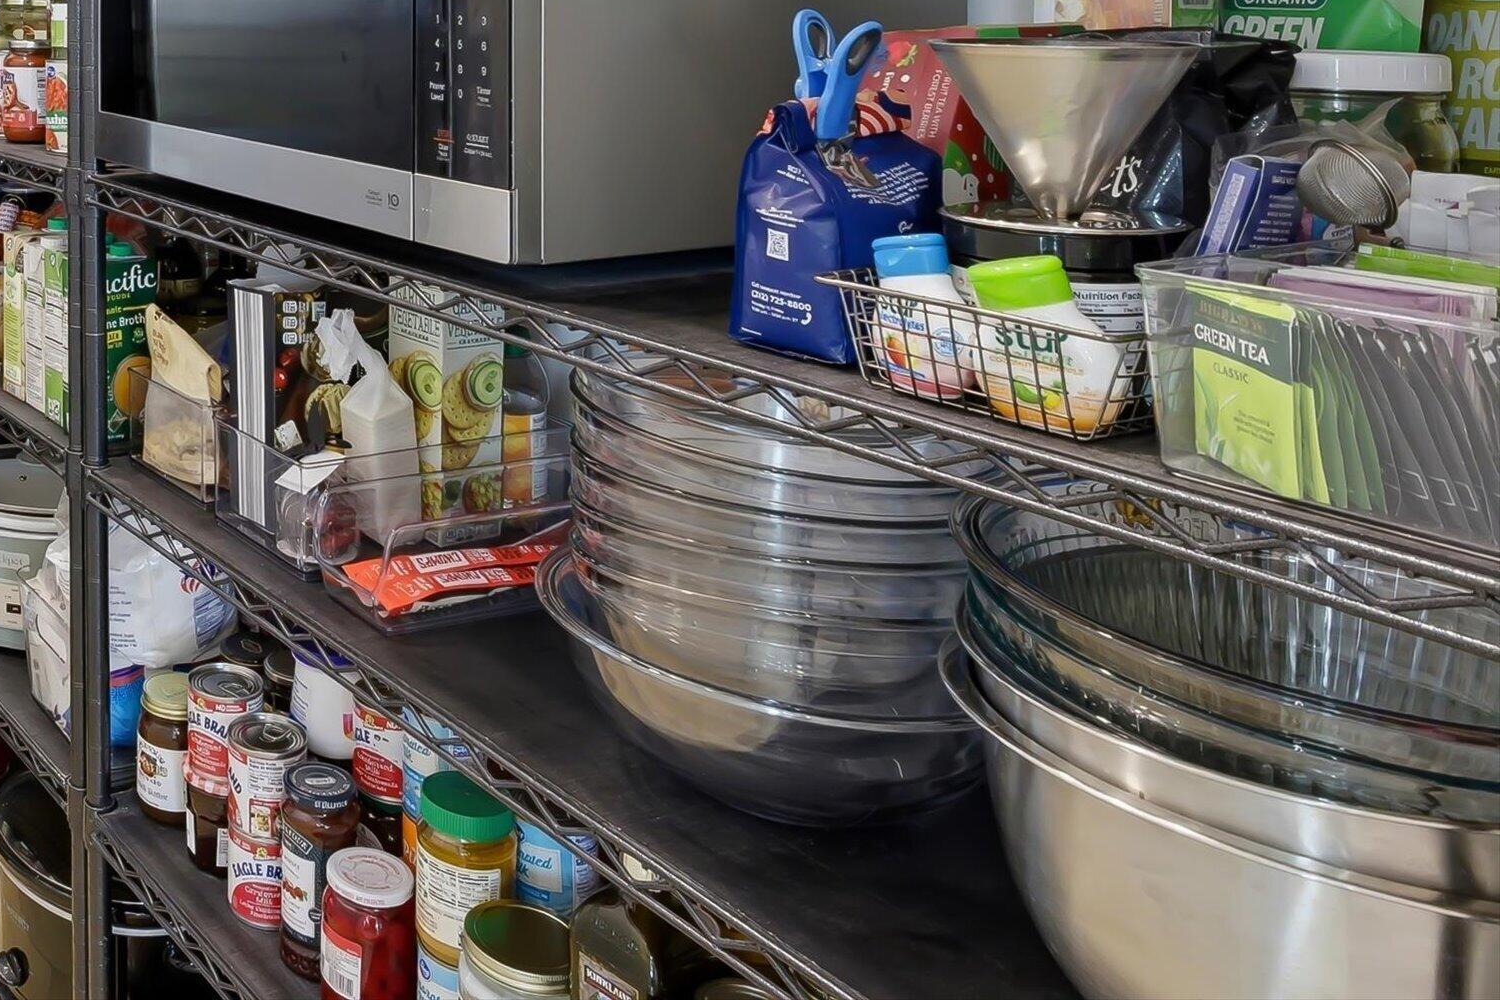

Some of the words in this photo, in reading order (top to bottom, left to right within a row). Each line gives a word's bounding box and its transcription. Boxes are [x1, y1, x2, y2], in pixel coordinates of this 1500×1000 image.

[435, 14, 440, 24] 1
[457, 15, 463, 25] 2
[481, 16, 487, 26] 3
[1223, 15, 1325, 50] GREEN
[434, 38, 440, 48] 4
[457, 39, 463, 50] 5
[481, 41, 487, 51] 6
[435, 61, 441, 72] 7
[457, 64, 463, 74] 8
[481, 66, 487, 76] 9
[457, 88, 463, 99] 0
[106, 264, 157, 294] cific
[1073, 291, 1119, 301] Nutrition
[119, 311, 146, 327] Broth
[1194, 322, 1236, 354] GREEN
[1238, 337, 1271, 367] TEA
[1213, 361, 1250, 384] CLASSIC
[417, 552, 464, 570] CHOMPS
[232, 862, 263, 879] EAGLE
